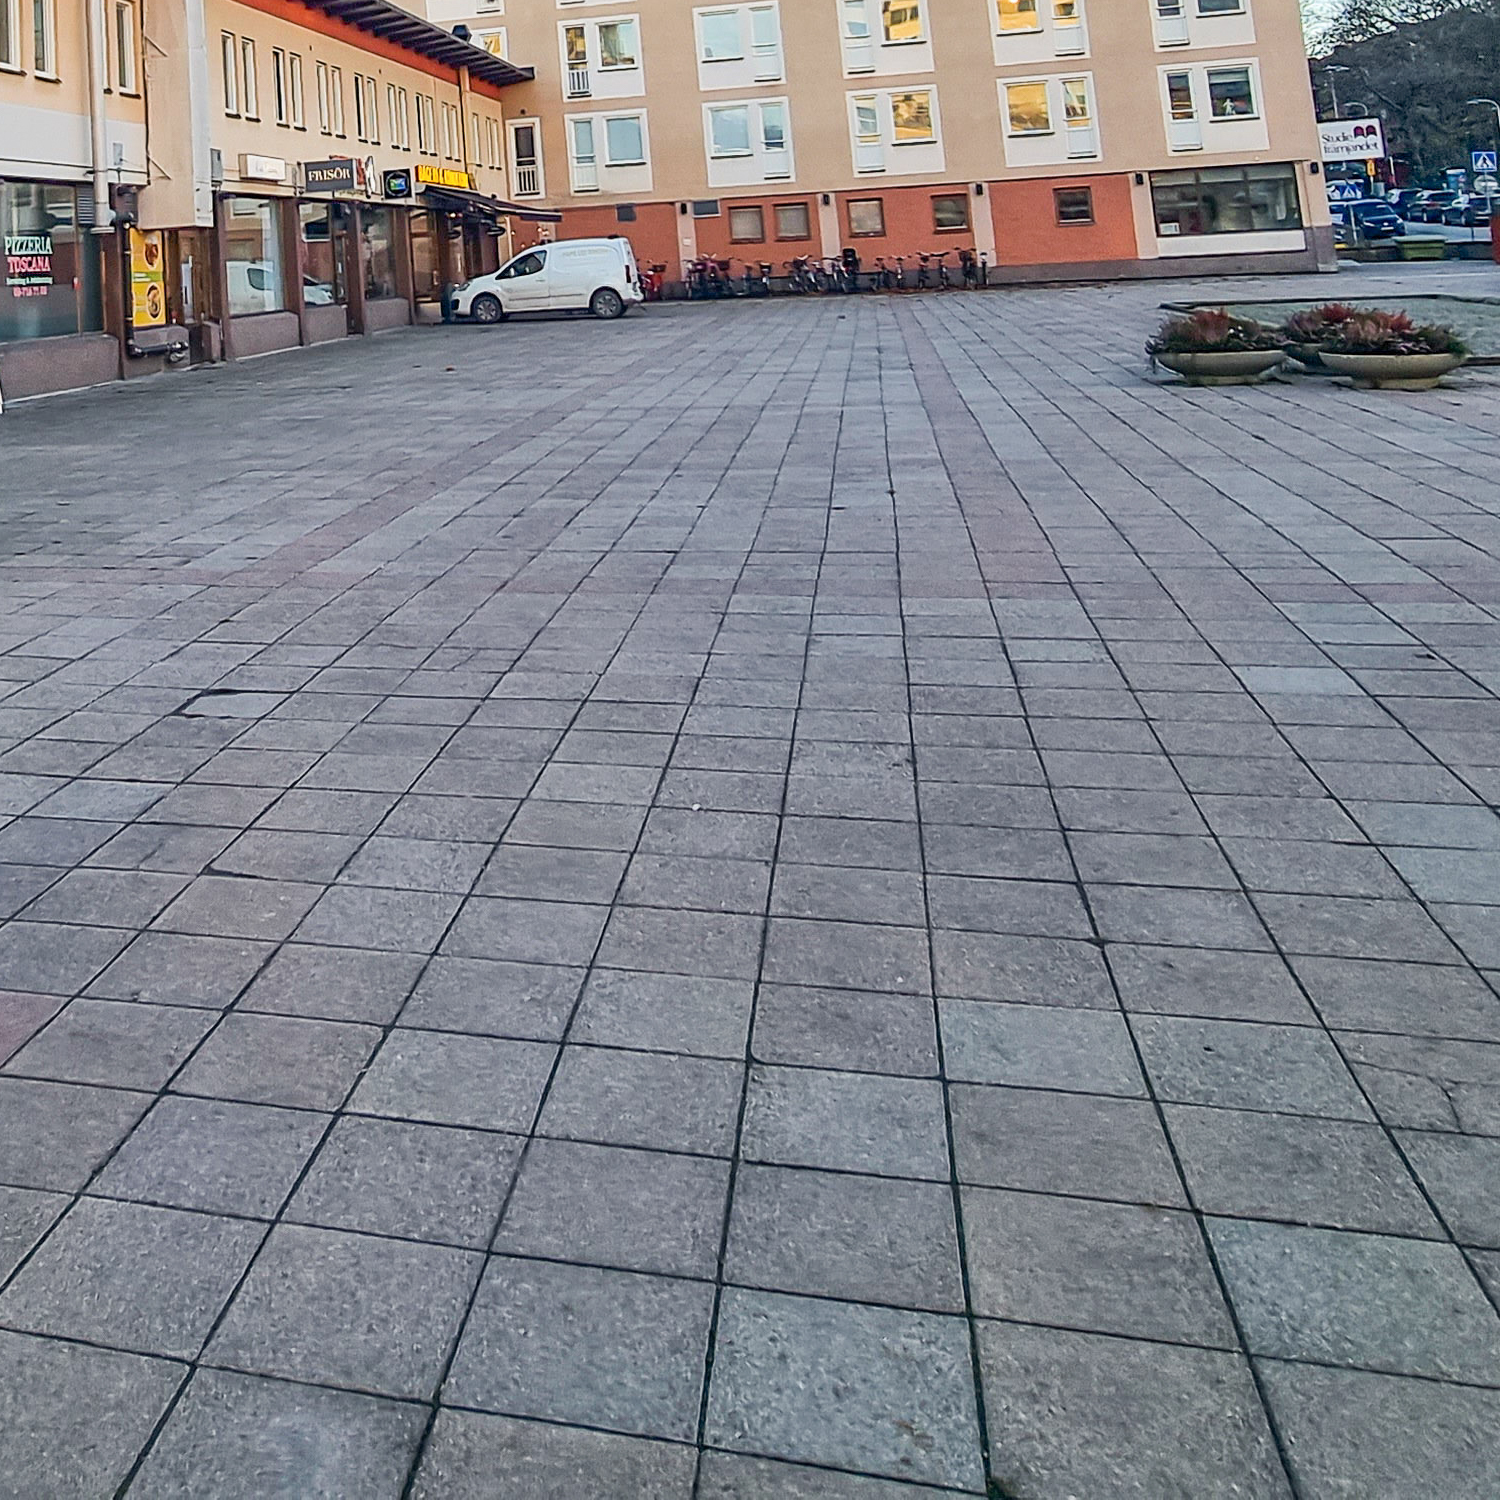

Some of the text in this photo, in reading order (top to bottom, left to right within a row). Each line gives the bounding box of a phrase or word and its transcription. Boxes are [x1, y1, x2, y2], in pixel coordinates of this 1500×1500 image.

[308, 166, 350, 182] FRISÖR
[4, 236, 53, 255] PIZZERIA
[7, 256, 51, 273] TOSCANA
